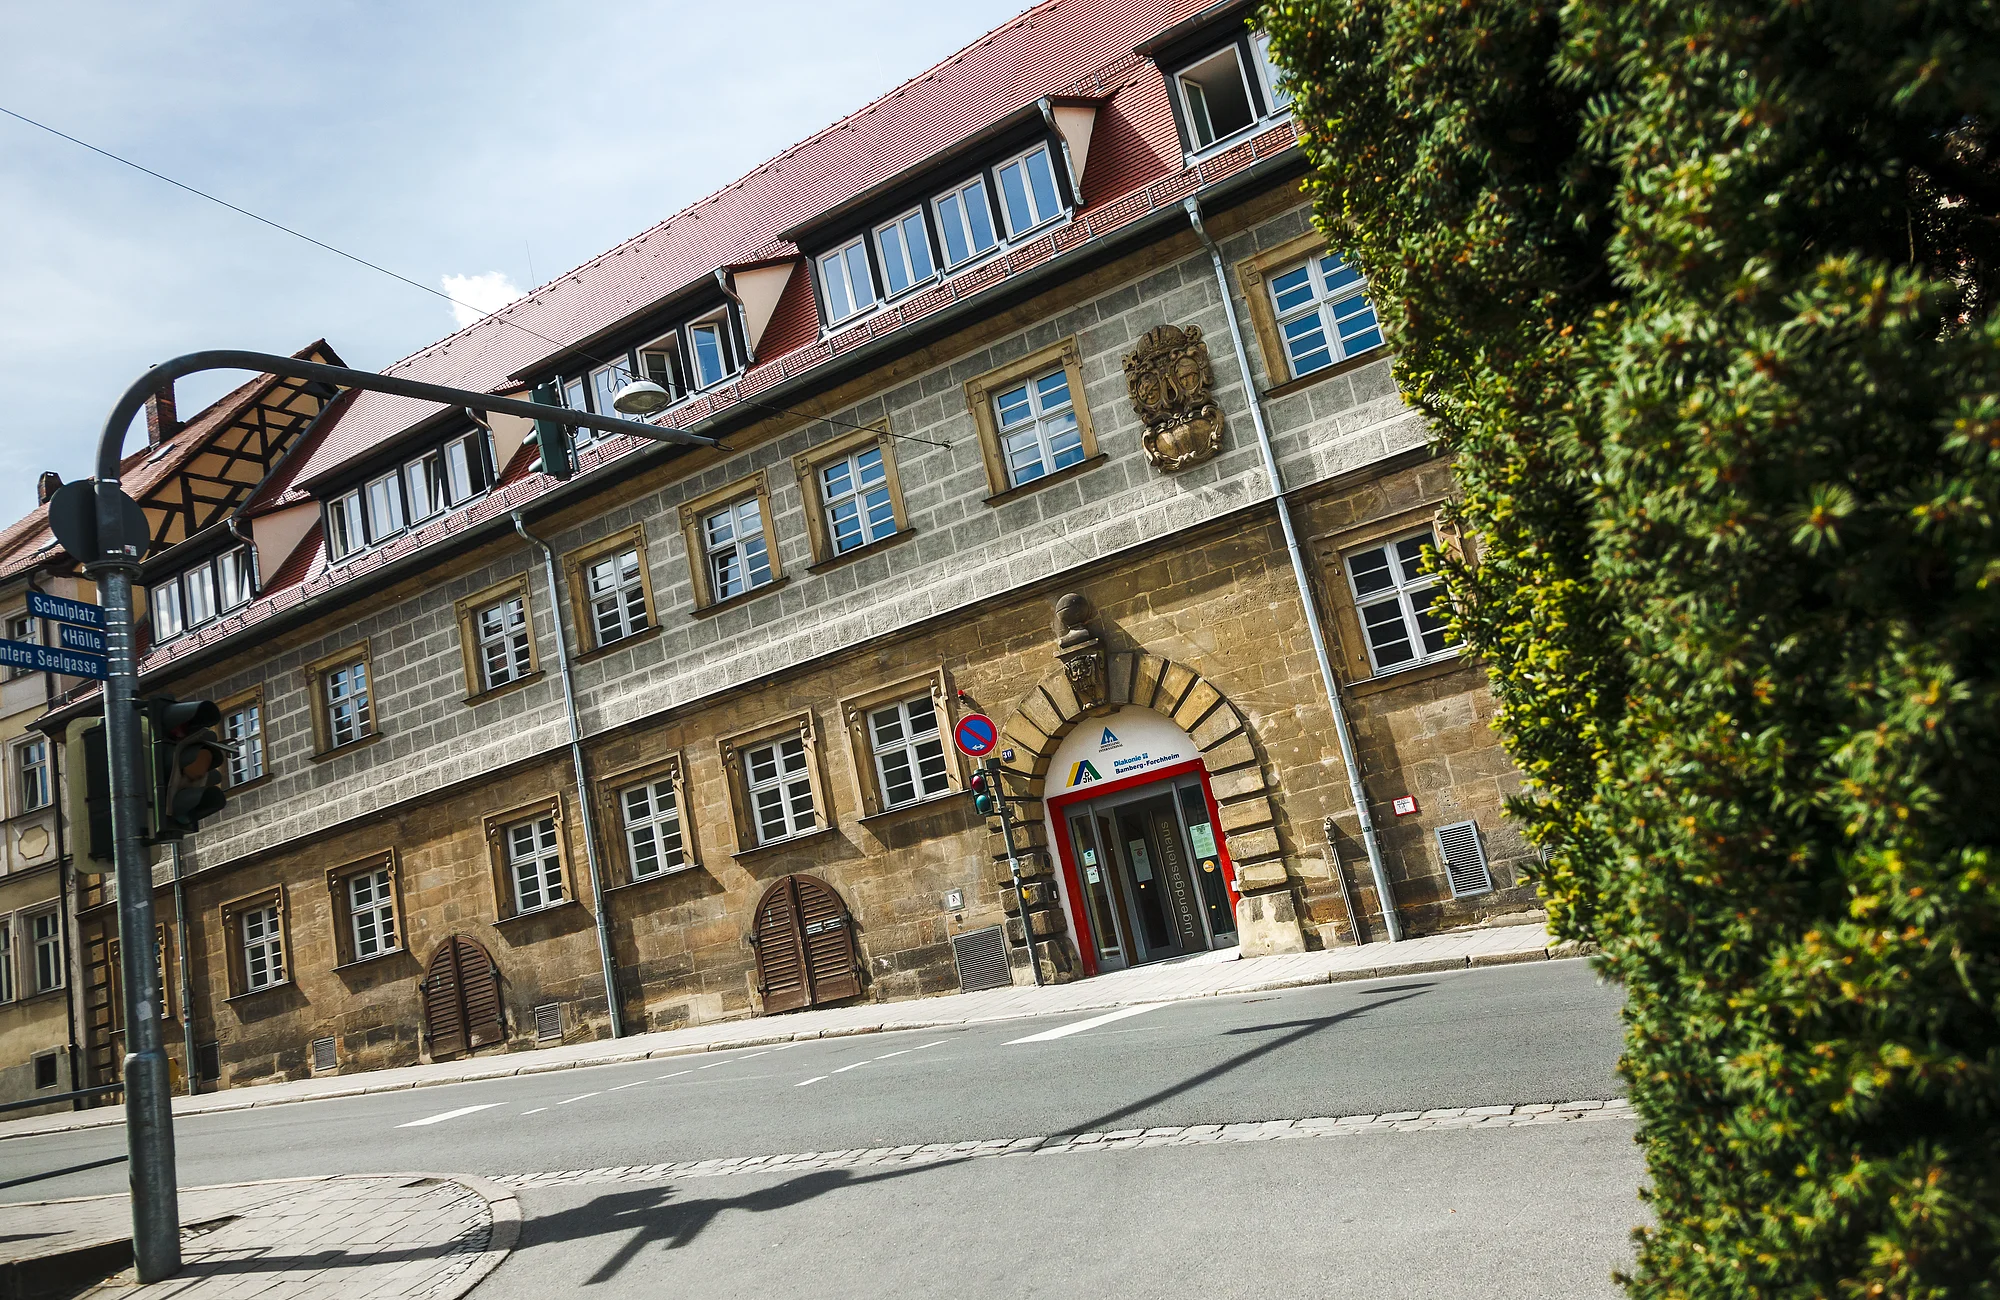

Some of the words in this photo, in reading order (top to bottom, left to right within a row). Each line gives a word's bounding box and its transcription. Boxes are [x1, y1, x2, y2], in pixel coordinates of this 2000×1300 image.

[33, 596, 97, 623] Schulplatz
[69, 629, 101, 649] Hölle
[37, 650, 97, 674] Seelgasse
[1113, 755, 1142, 767] Diakonie
[1115, 753, 1180, 775] Bamberg-Forchheim
[1160, 821, 1195, 938] Jugendgästehaus
